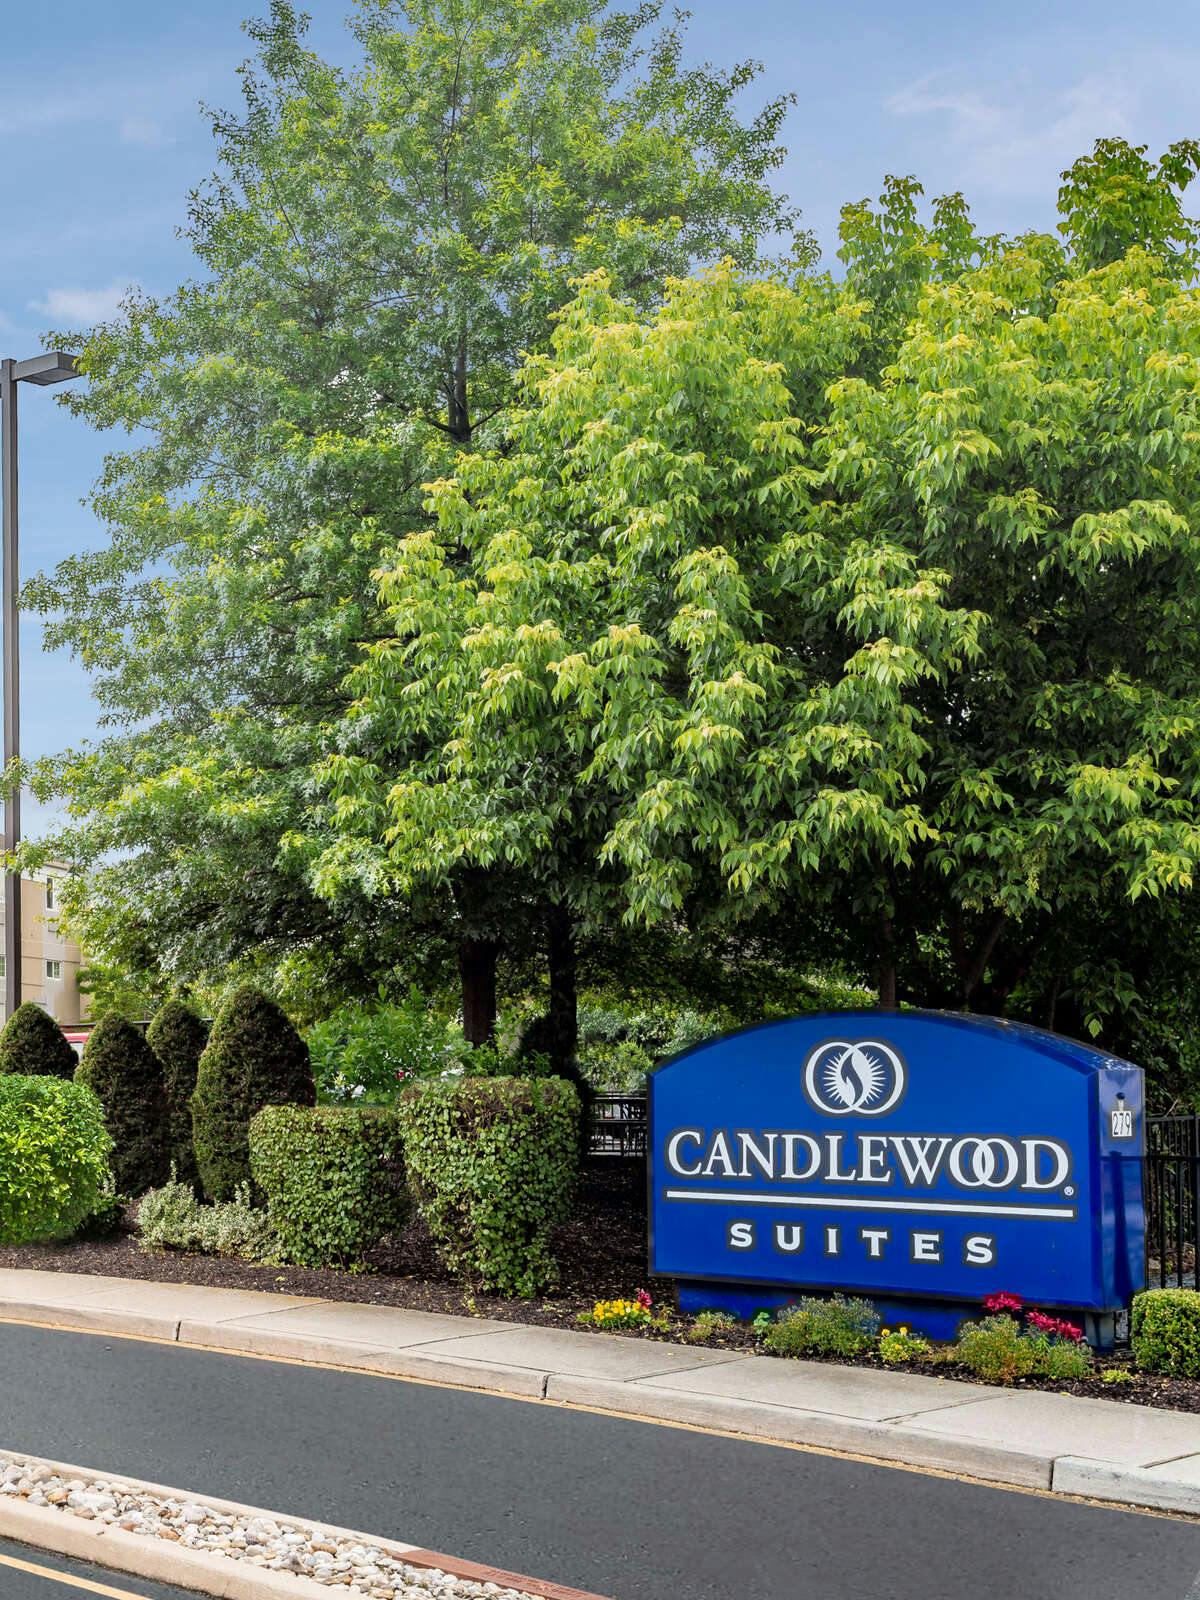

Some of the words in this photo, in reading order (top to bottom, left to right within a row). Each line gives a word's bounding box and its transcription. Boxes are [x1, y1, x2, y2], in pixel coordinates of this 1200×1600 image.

[1113, 1112, 1131, 1135] 279
[668, 1130, 1070, 1189] CANDLEWOOD
[729, 1222, 994, 1264] SUITES
